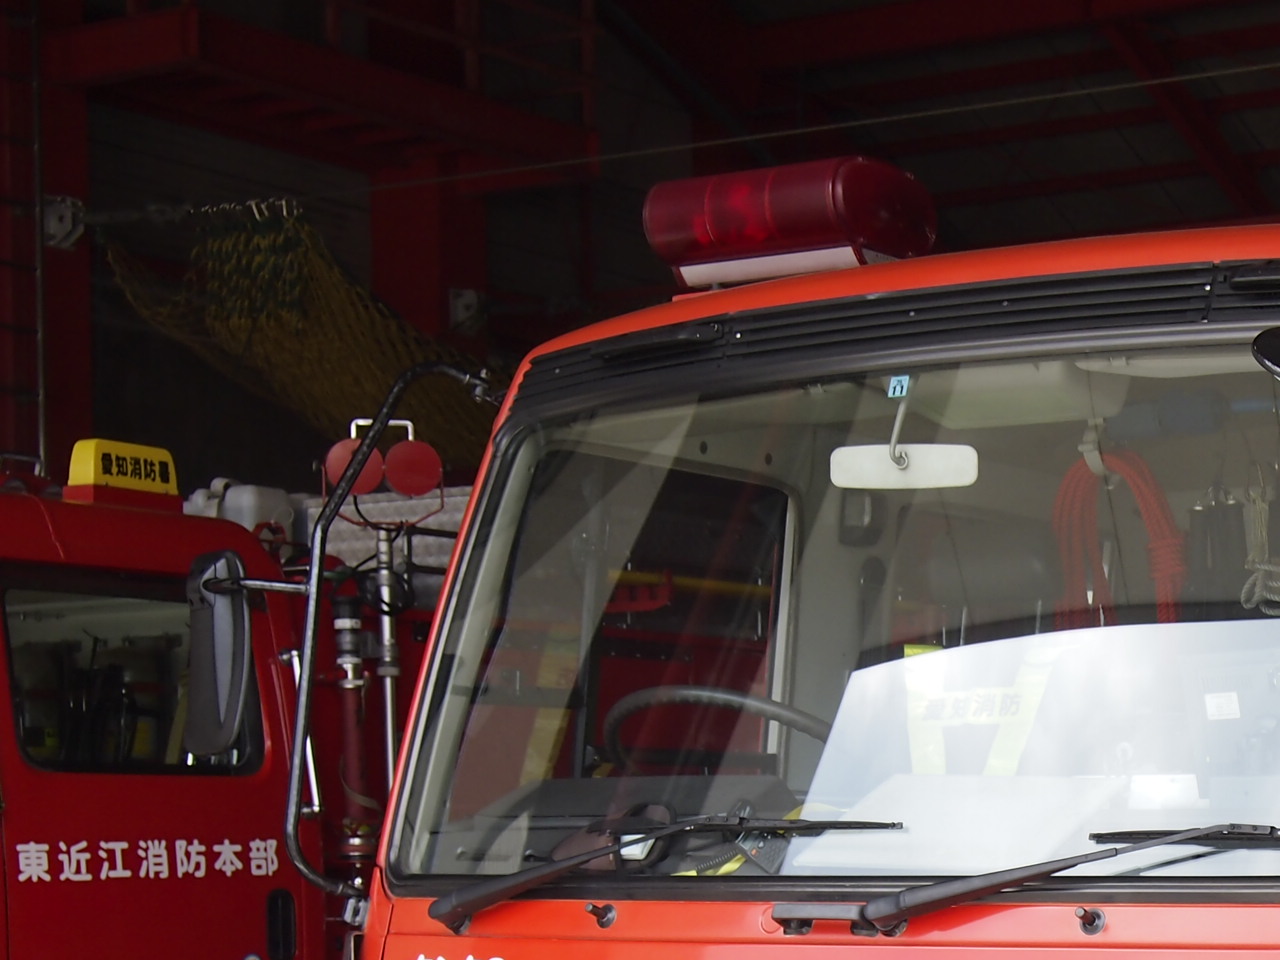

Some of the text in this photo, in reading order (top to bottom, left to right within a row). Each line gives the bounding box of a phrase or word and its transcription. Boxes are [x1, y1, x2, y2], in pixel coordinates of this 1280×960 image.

[16, 838, 280, 882] 東近江消防本部
